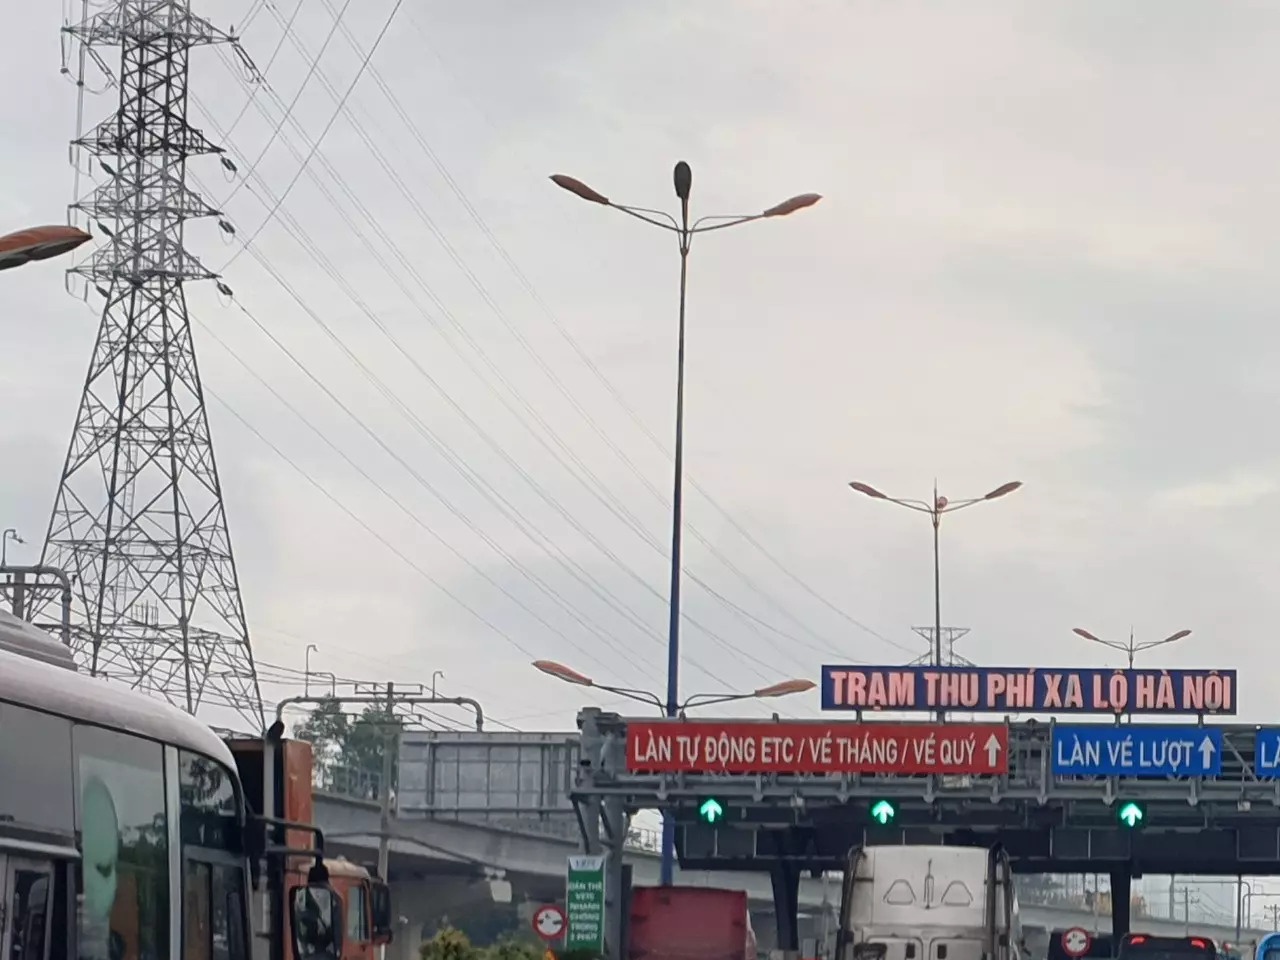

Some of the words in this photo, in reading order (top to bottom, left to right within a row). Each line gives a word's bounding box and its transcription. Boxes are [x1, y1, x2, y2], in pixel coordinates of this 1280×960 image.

[830, 671, 915, 711] TRẠM
[924, 672, 979, 707] THU
[987, 668, 1035, 708] PHÍ
[1043, 674, 1083, 709] XA
[1093, 669, 1128, 713] LỘ
[1136, 669, 1176, 709] HÀ
[1183, 670, 1231, 714] NỘI
[634, 729, 672, 763] LÀN
[676, 734, 701, 768] TỰ
[704, 731, 755, 768] ĐỘNG
[761, 737, 794, 764] ETC
[797, 738, 806, 764] /
[809, 730, 832, 764] VÉ
[836, 731, 898, 765] THÁNG
[901, 739, 909, 765] /
[913, 731, 936, 765] VÉ
[940, 732, 976, 765] QUÝ
[1057, 734, 1100, 767] LÀN
[1107, 734, 1133, 767] VÉ
[1139, 738, 1194, 773] LƯỢT
